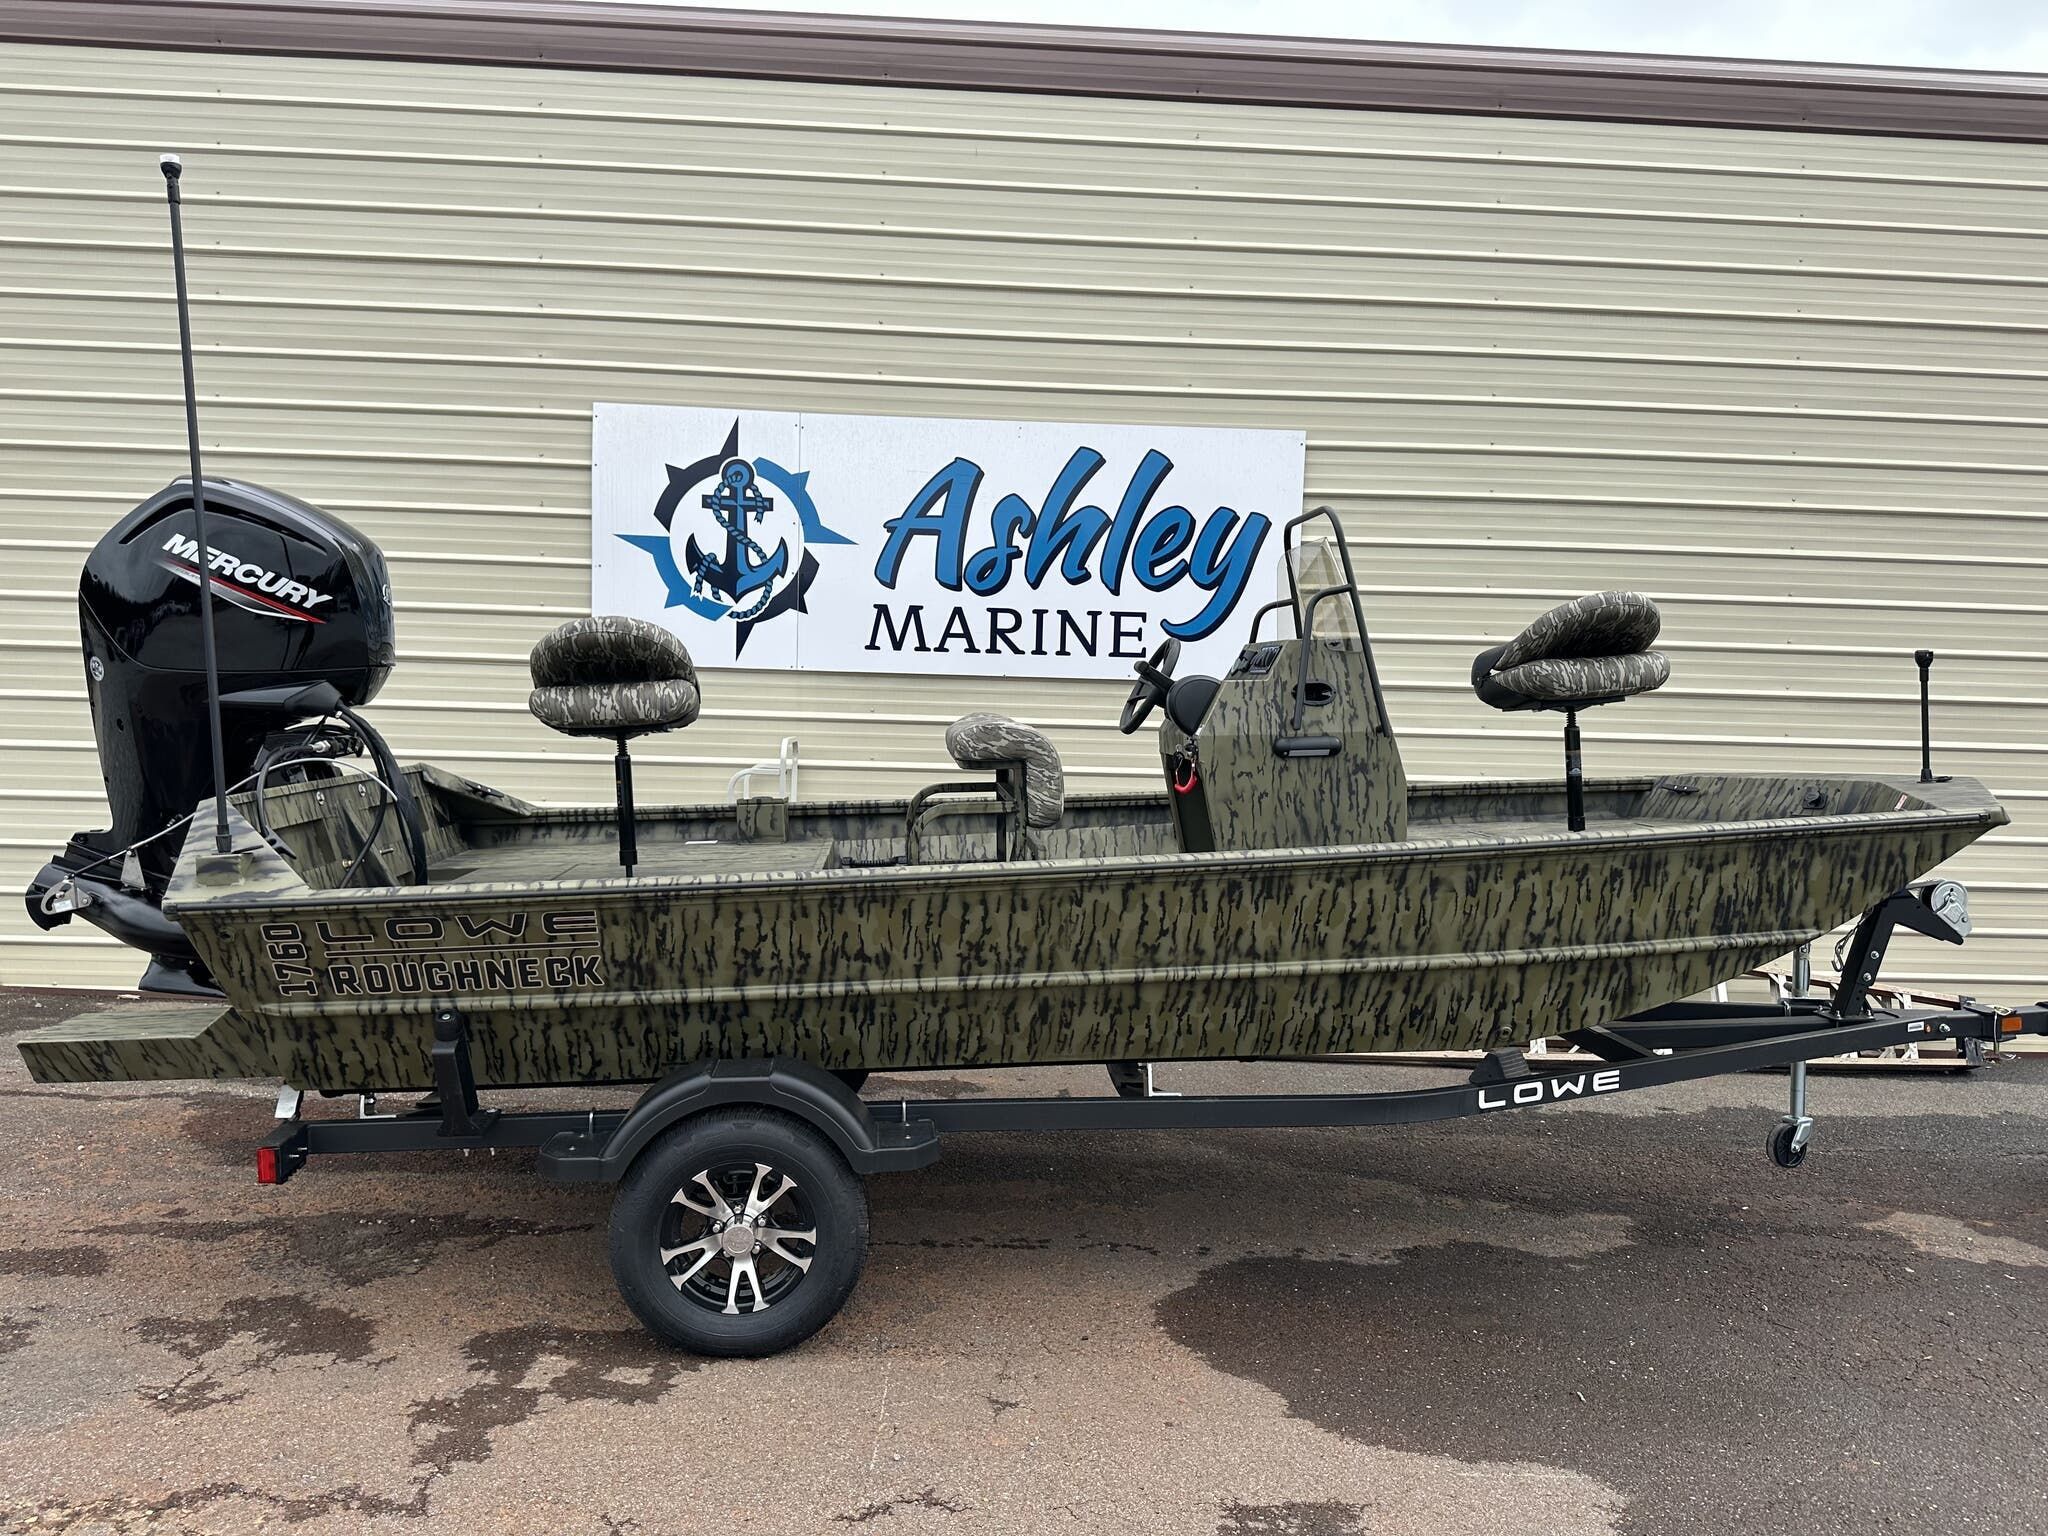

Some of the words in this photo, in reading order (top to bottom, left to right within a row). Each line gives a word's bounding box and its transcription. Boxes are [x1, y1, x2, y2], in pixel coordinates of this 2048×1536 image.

[162, 533, 333, 609] MERCURY
[874, 446, 1272, 642] Ashley
[864, 603, 1148, 658] MARINE
[315, 910, 599, 945] LOWE
[260, 922, 318, 997] 1760
[327, 955, 605, 996] ROUGHNECK
[1478, 1069, 1620, 1110] LOWE
